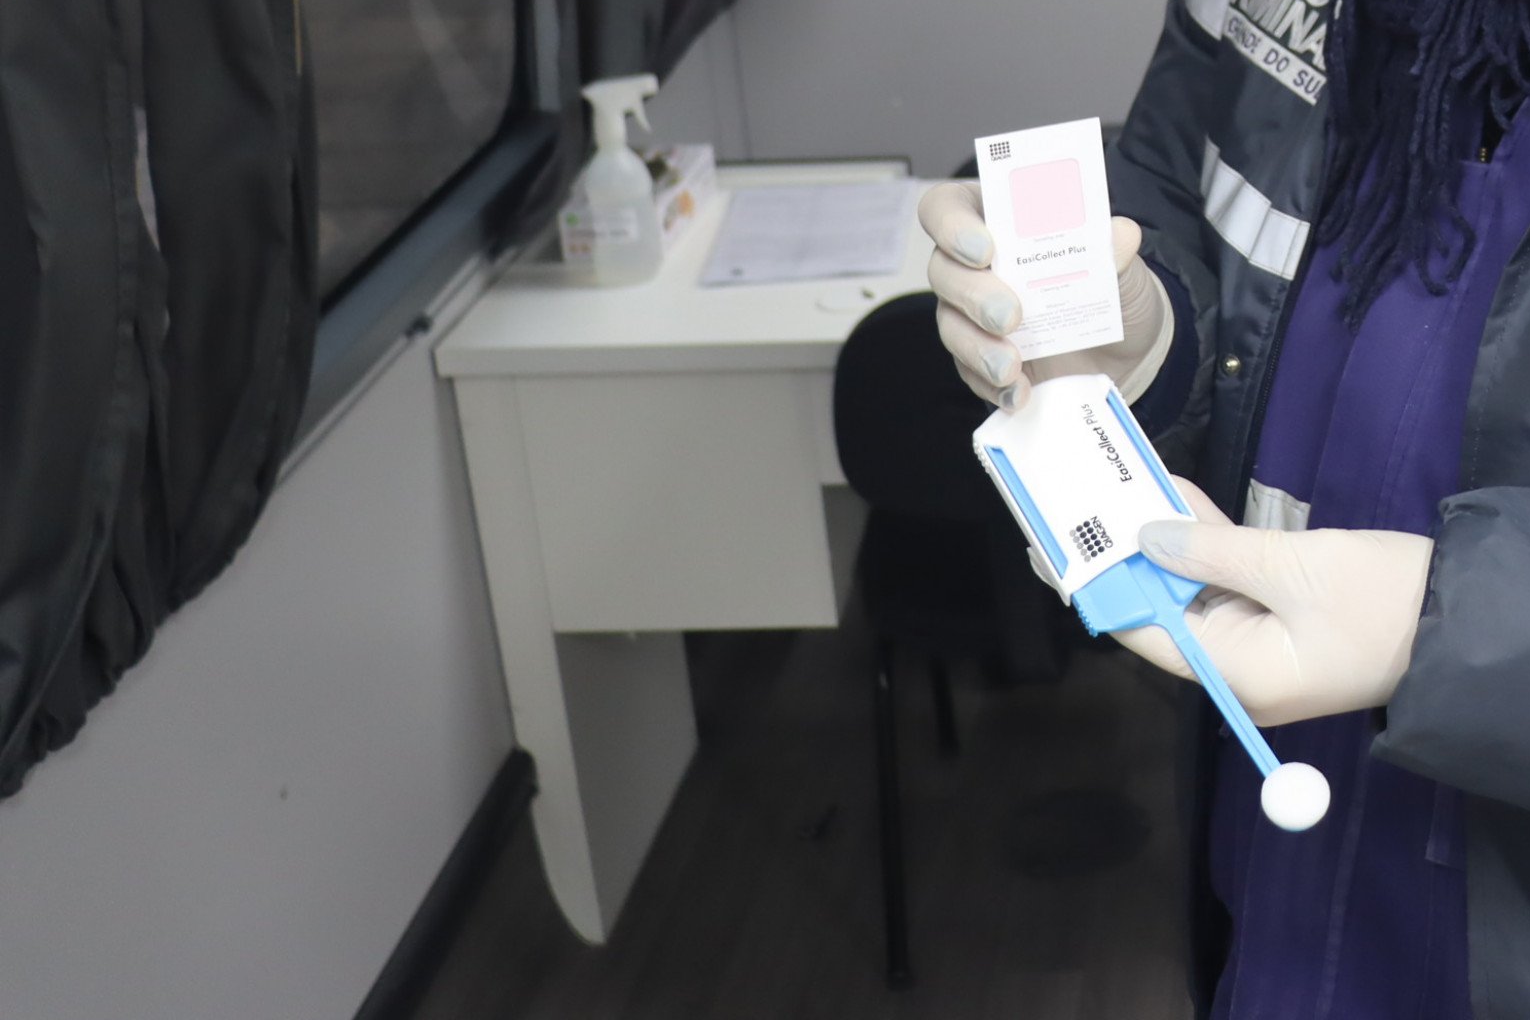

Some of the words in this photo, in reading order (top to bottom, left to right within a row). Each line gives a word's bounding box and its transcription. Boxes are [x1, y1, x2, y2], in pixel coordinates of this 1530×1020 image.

[1263, 47, 1291, 73] DO
[1016, 249, 1066, 266] EasiCollect
[1068, 245, 1087, 255] Plus
[1080, 403, 1098, 426] Plus
[1092, 426, 1132, 483] EasiCollect
